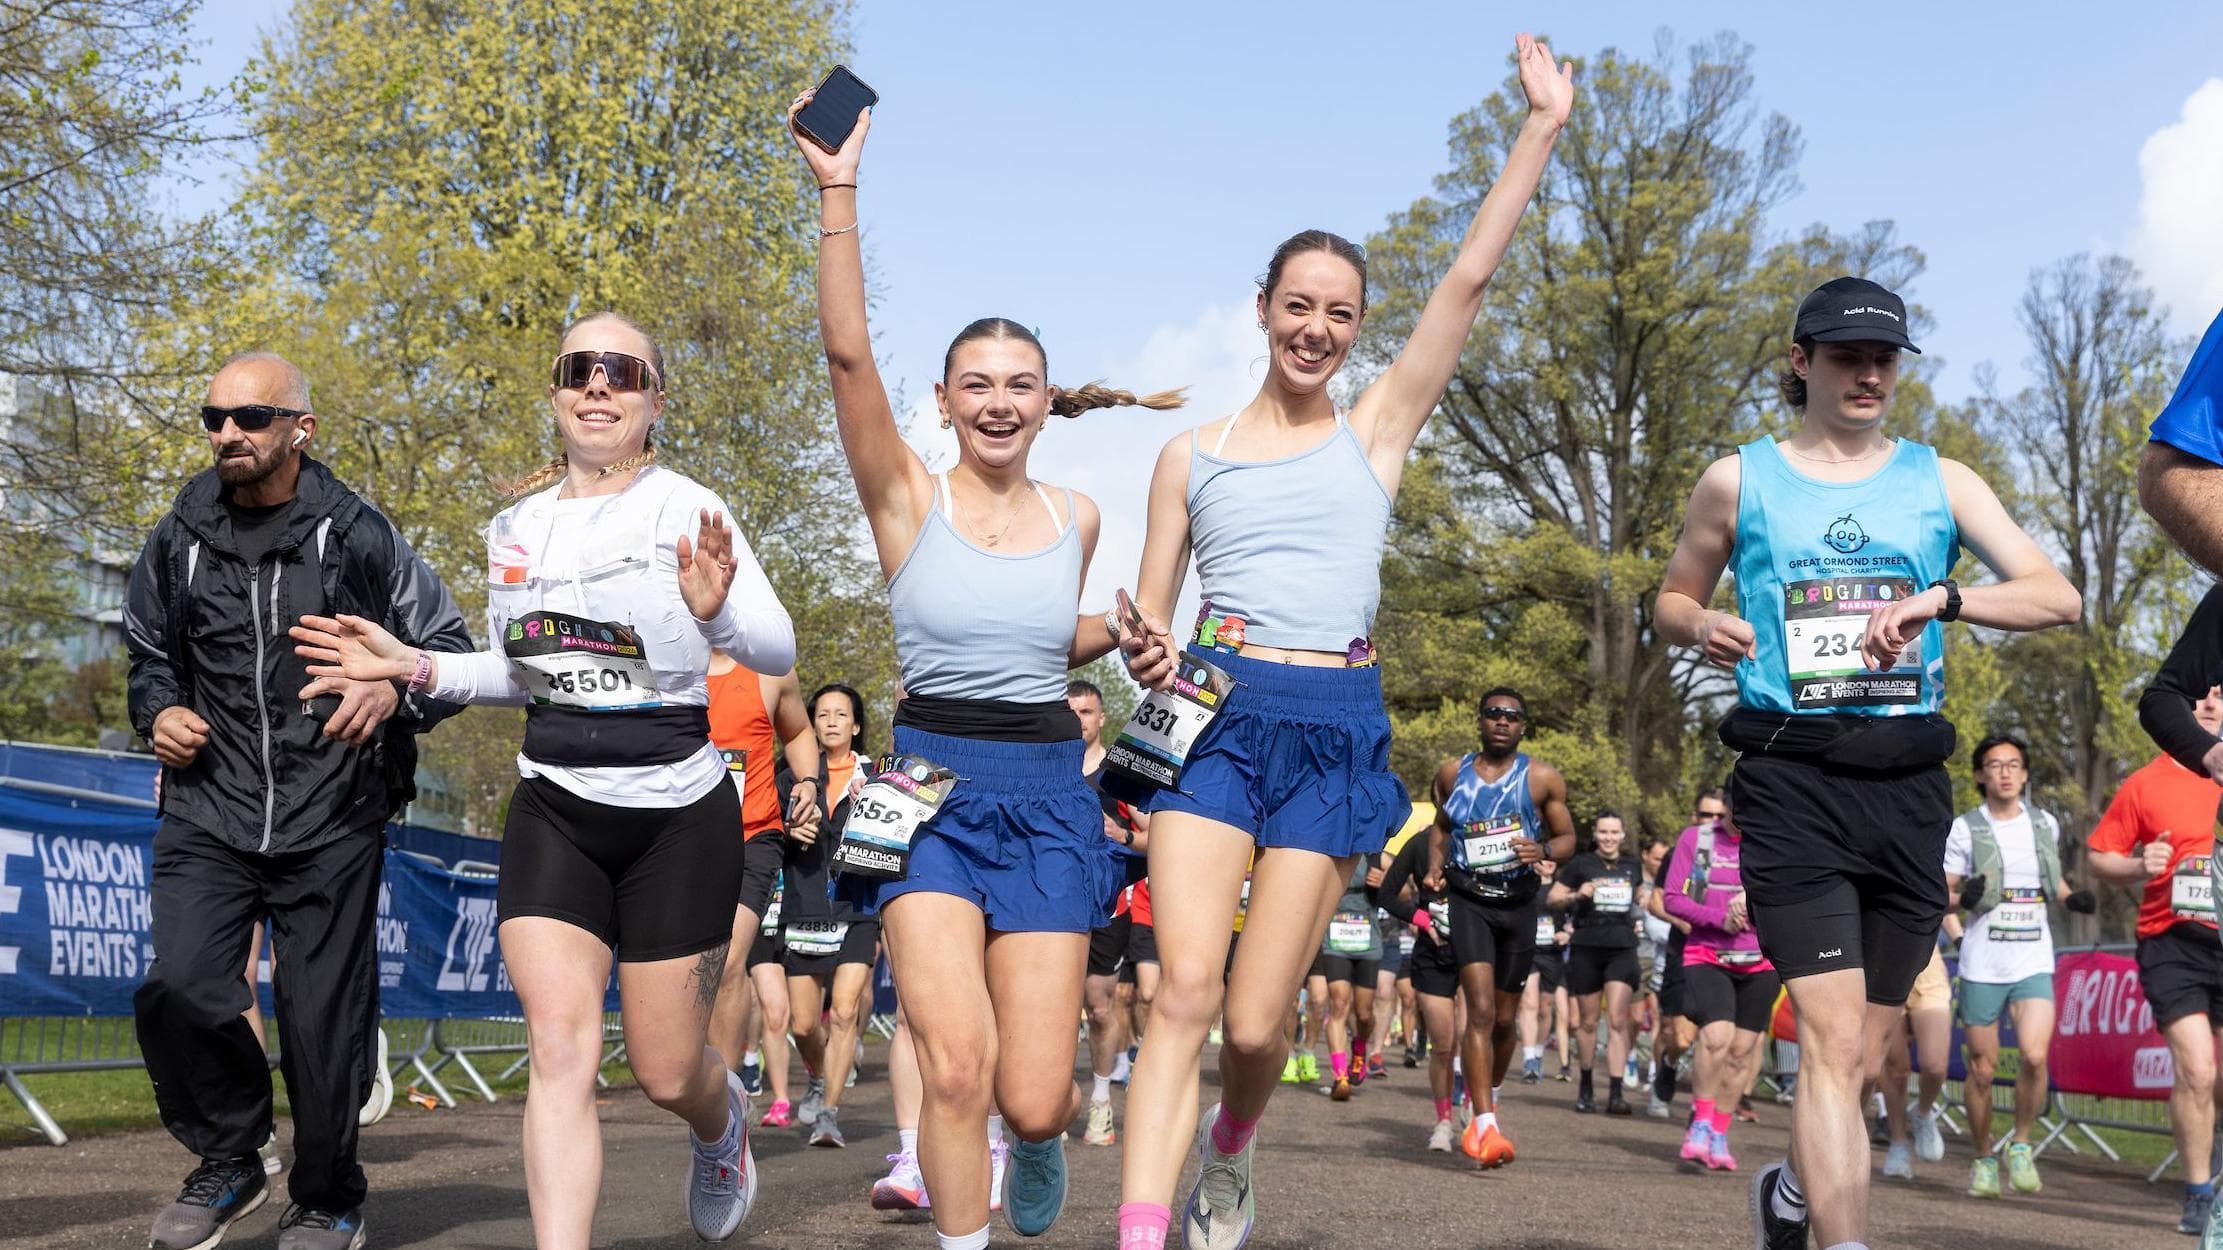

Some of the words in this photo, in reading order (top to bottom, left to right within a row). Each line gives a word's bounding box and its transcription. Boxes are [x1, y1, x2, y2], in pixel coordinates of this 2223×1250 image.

[1843, 307, 1865, 316] Acid
[1867, 306, 1899, 322] Running
[1789, 558, 1821, 569] GREAT
[1824, 557, 1869, 566] ORMOND
[1873, 556, 1909, 565] STREET
[509, 618, 633, 644] BRIGHTON
[1794, 627, 1801, 637] 2
[563, 637, 617, 652] MARATHON
[1831, 681, 1869, 691] LONDON
[1871, 680, 1916, 689] MARATHON
[1831, 689, 1864, 699] EVENTS
[1109, 745, 1136, 761] LONDON
[1134, 755, 1174, 779] MARATHON
[853, 797, 903, 824] 559
[849, 846, 901, 864] MARATHON
[1480, 843, 1512, 856] 2714
[36, 833, 145, 886] LONDON
[45, 881, 153, 931] MARATH
[50, 929, 137, 977] EVENTS
[1818, 948, 1842, 960] Acid
